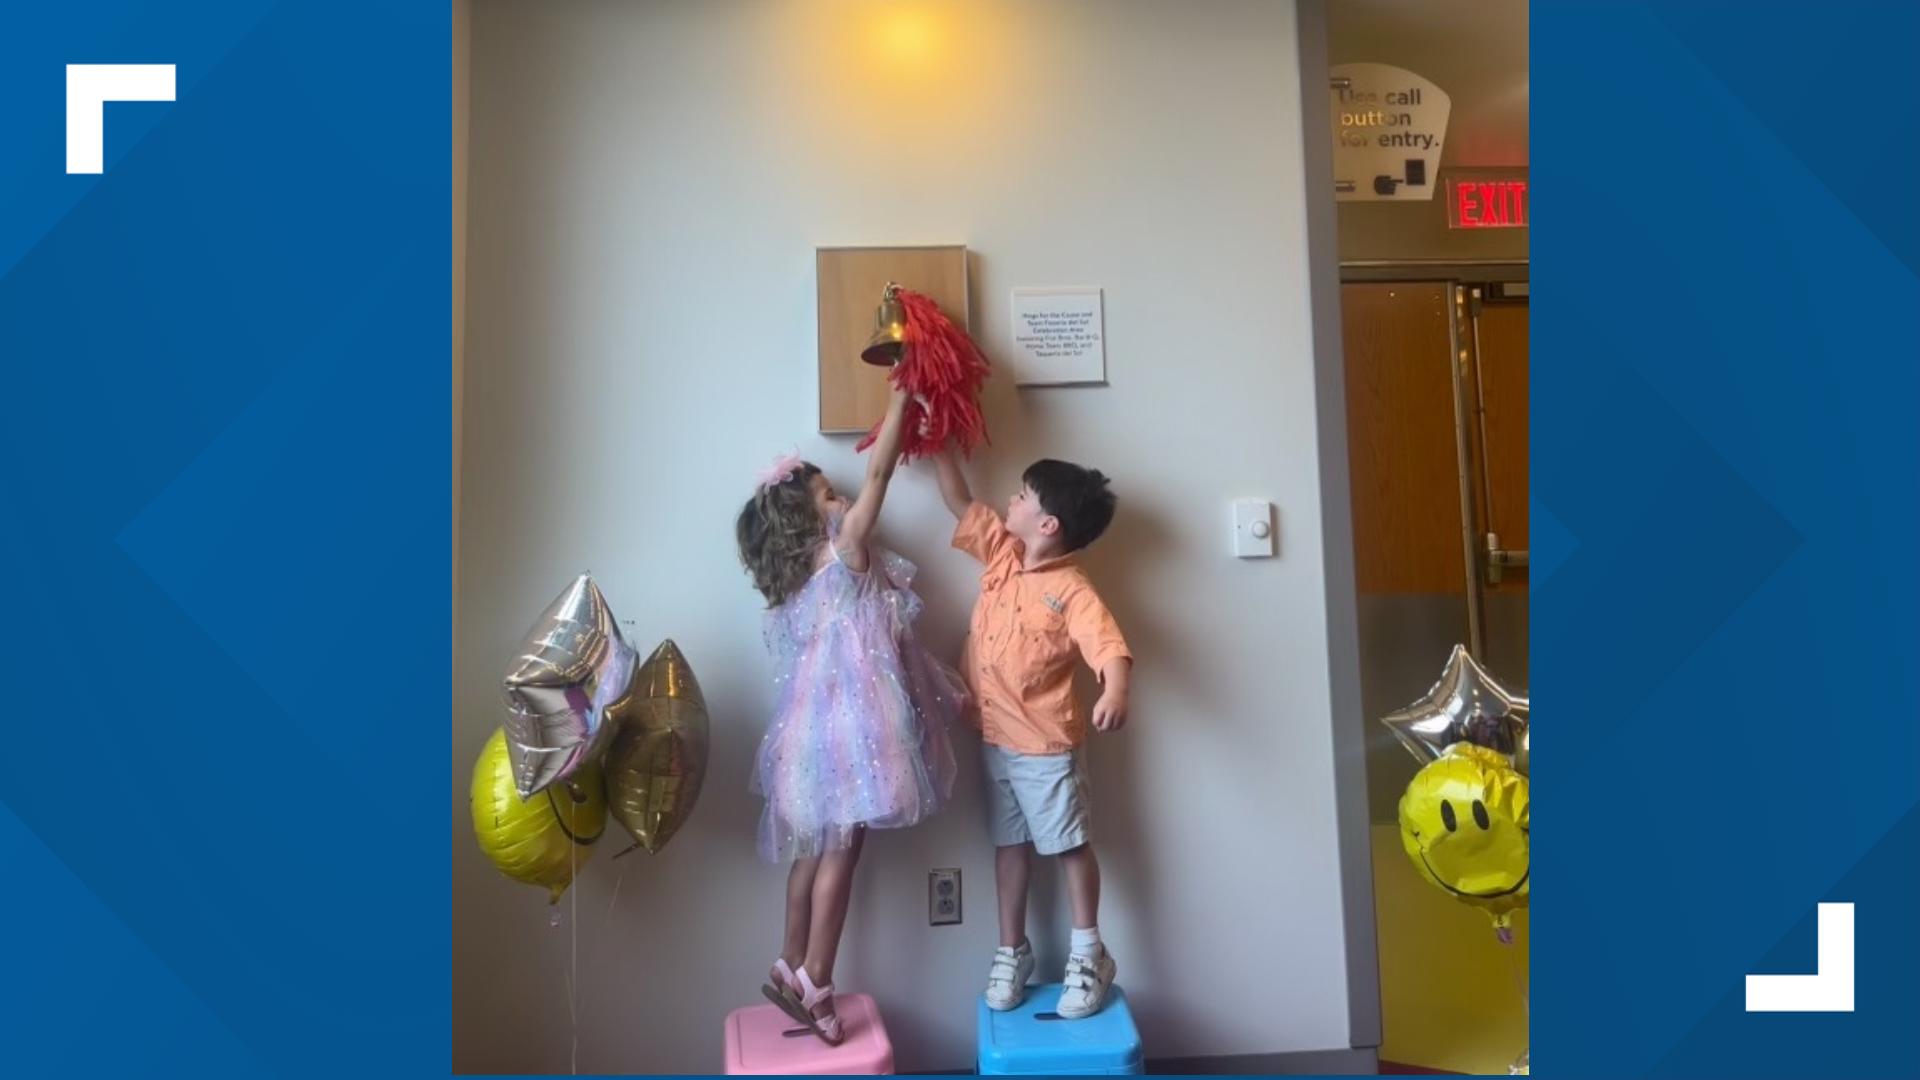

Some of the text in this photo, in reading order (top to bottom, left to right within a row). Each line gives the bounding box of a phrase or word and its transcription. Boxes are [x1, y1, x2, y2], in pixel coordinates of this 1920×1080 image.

[1338, 88, 1422, 106] Use call
[1341, 110, 1412, 127] button
[1340, 130, 1440, 150] for entry.
[1457, 181, 1526, 227] EXIT
